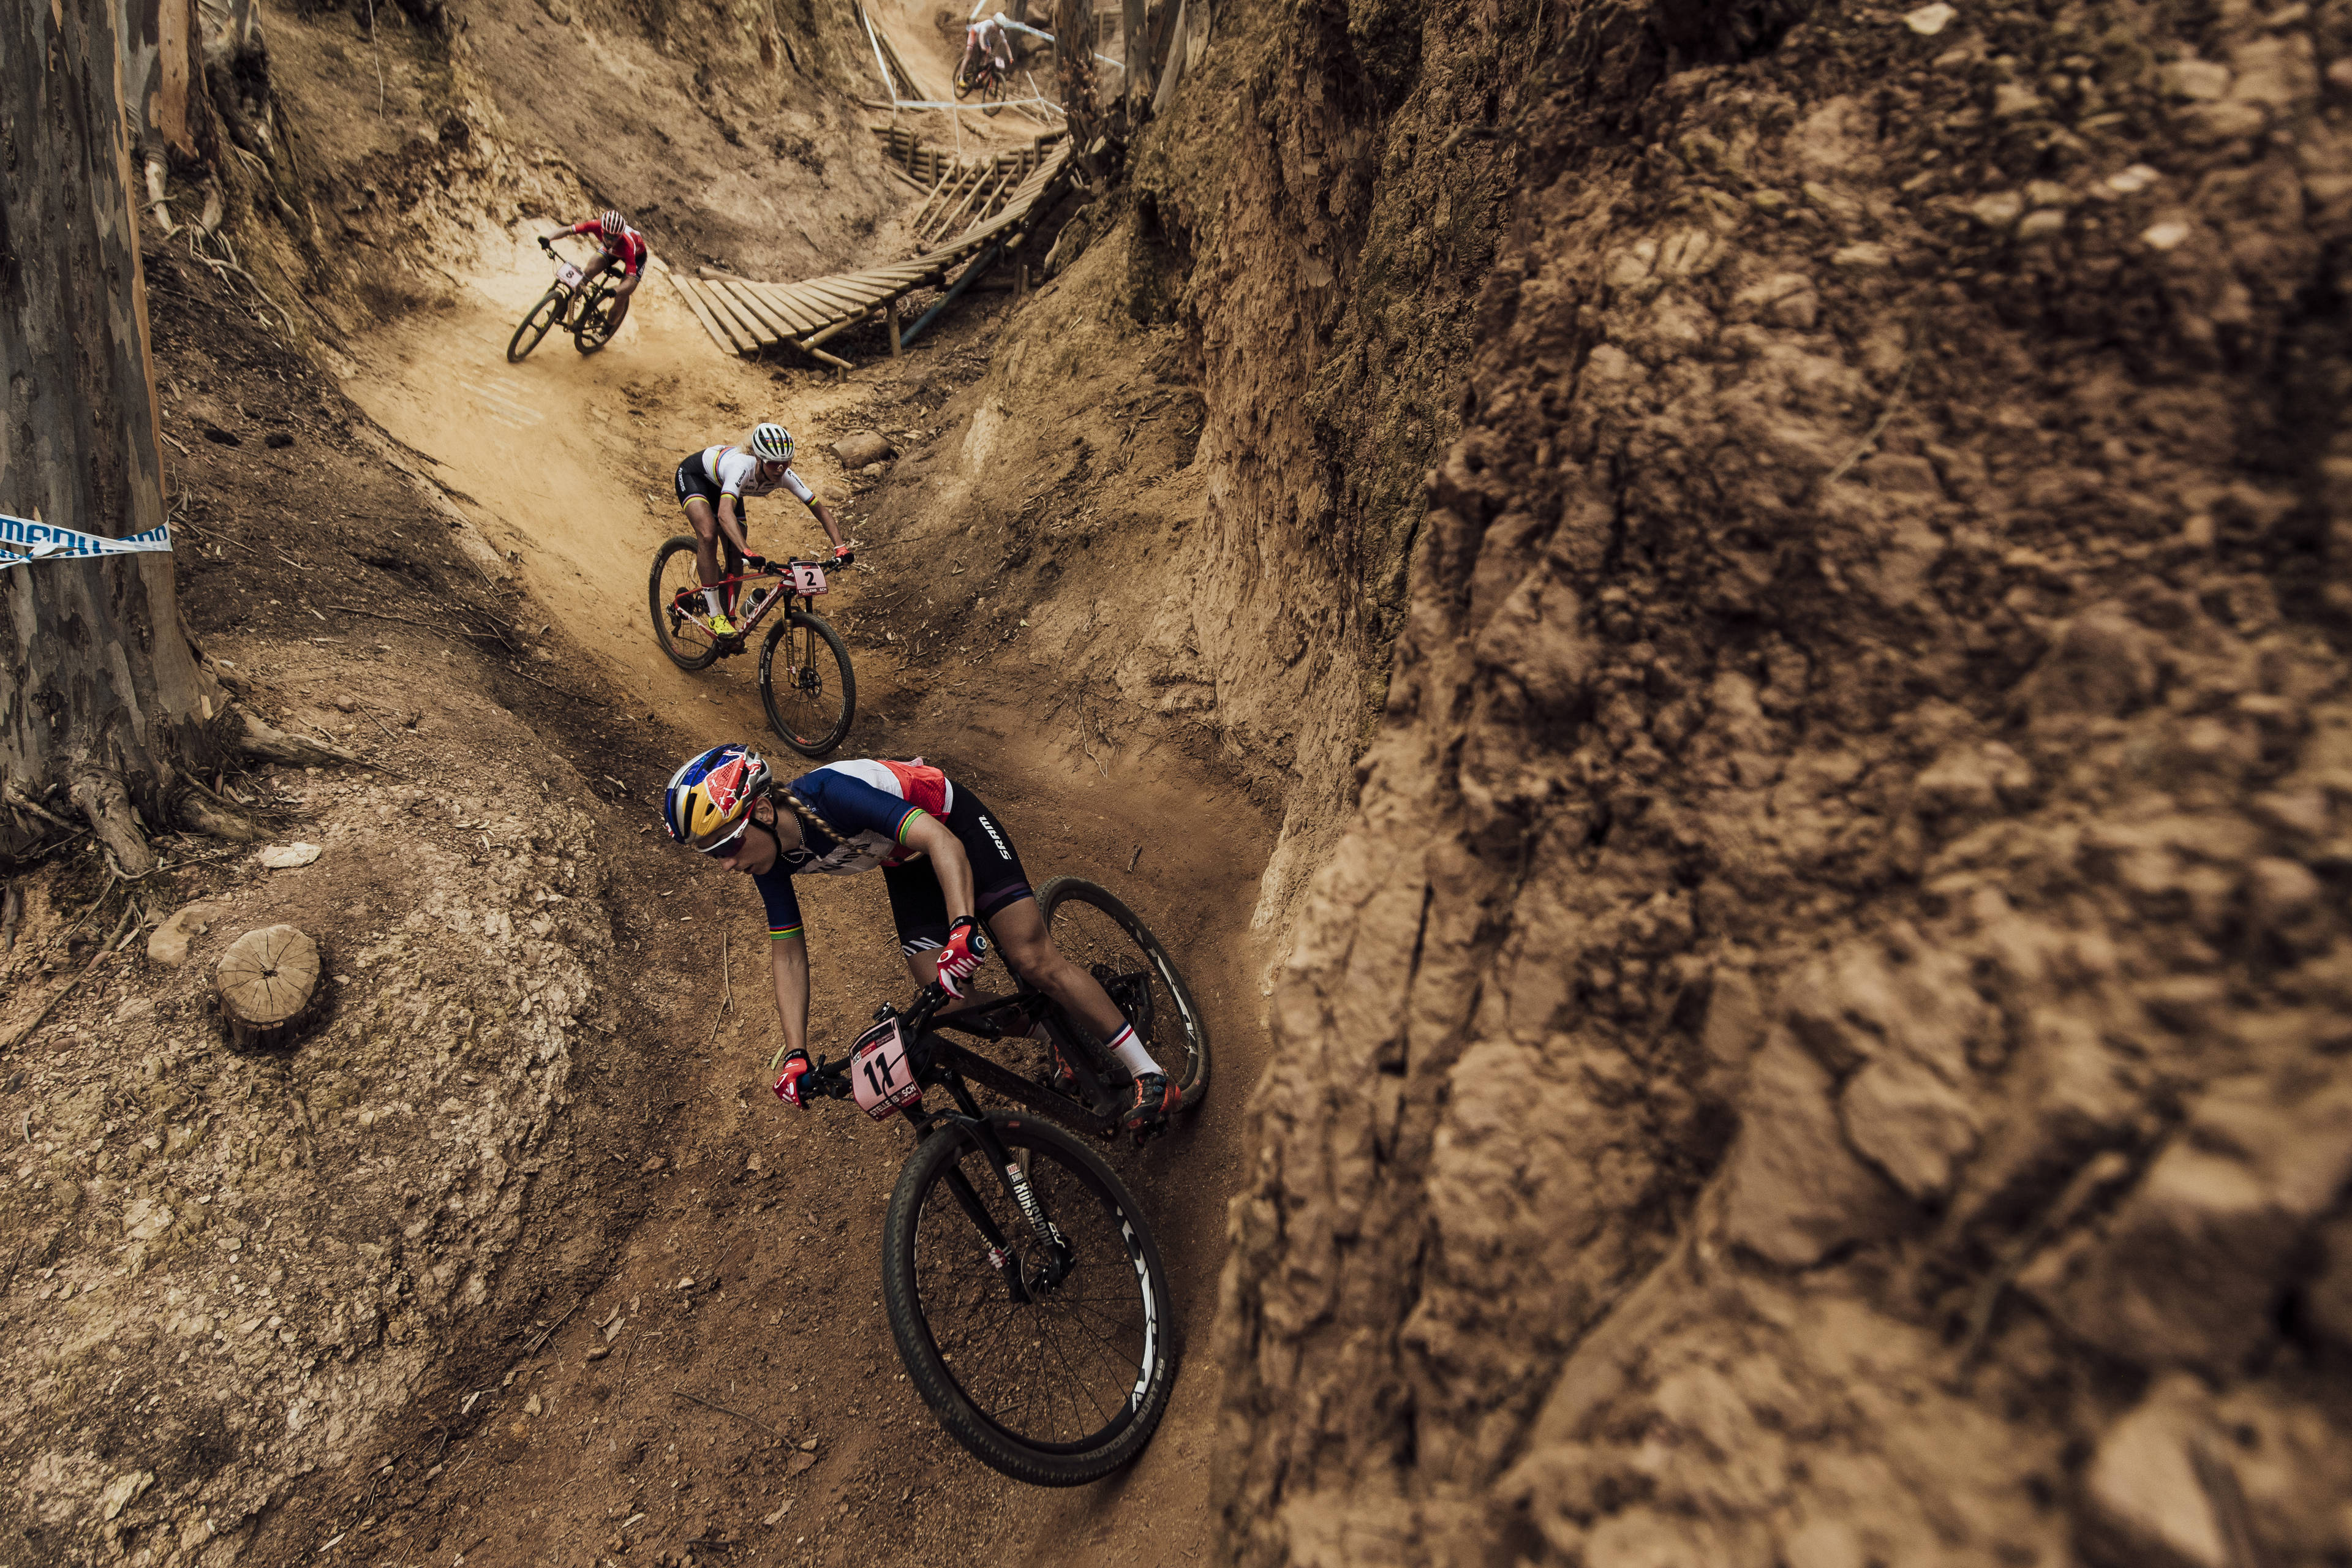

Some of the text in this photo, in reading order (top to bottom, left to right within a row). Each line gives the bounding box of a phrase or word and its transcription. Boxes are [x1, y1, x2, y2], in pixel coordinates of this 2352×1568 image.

[805, 571, 816, 586] 2
[979, 816, 1012, 860] SRAM
[864, 1052, 894, 1096] 11
[1014, 1182, 1054, 1246] ROCKSHOX
[1080, 1383, 1158, 1462] THUNDER BURT
